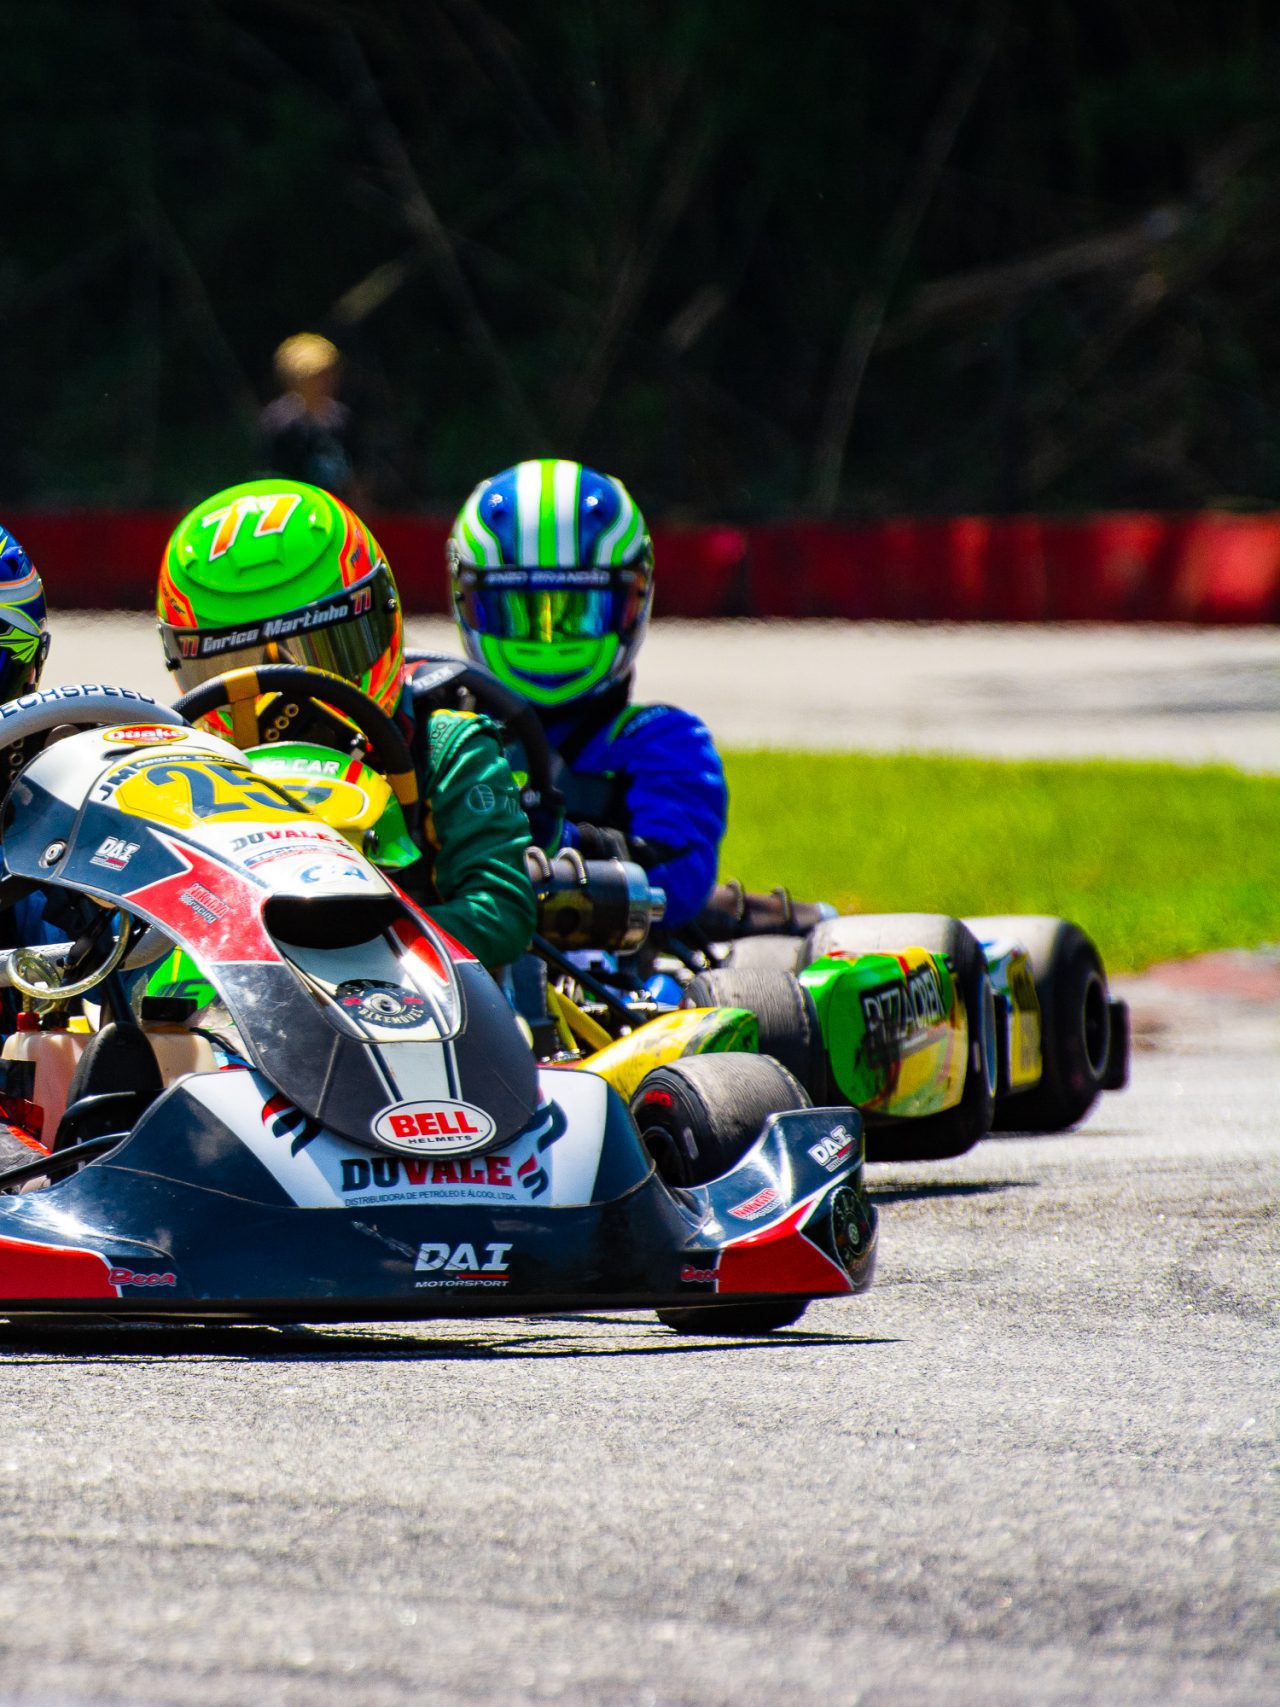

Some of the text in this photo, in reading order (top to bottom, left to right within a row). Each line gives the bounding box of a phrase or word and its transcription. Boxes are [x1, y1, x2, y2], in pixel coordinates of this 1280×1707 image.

[200, 493, 302, 562] 77
[178, 586, 372, 657] 77 Enrico Martinho 77
[292, 759, 340, 776] CAR
[95, 836, 140, 860] DAI
[388, 1111, 479, 1138] BELL
[408, 1135, 473, 1144] HELMETS
[808, 1125, 856, 1166] DAI
[341, 1156, 512, 1192] DUVALE
[345, 1193, 407, 1206] DISTRIBUIDORA
[419, 1189, 460, 1199] PETRÓLEO
[467, 1189, 496, 1199] ÁLCOOL
[415, 1243, 514, 1271] DAI
[415, 1280, 510, 1289] MOTORSPORT
